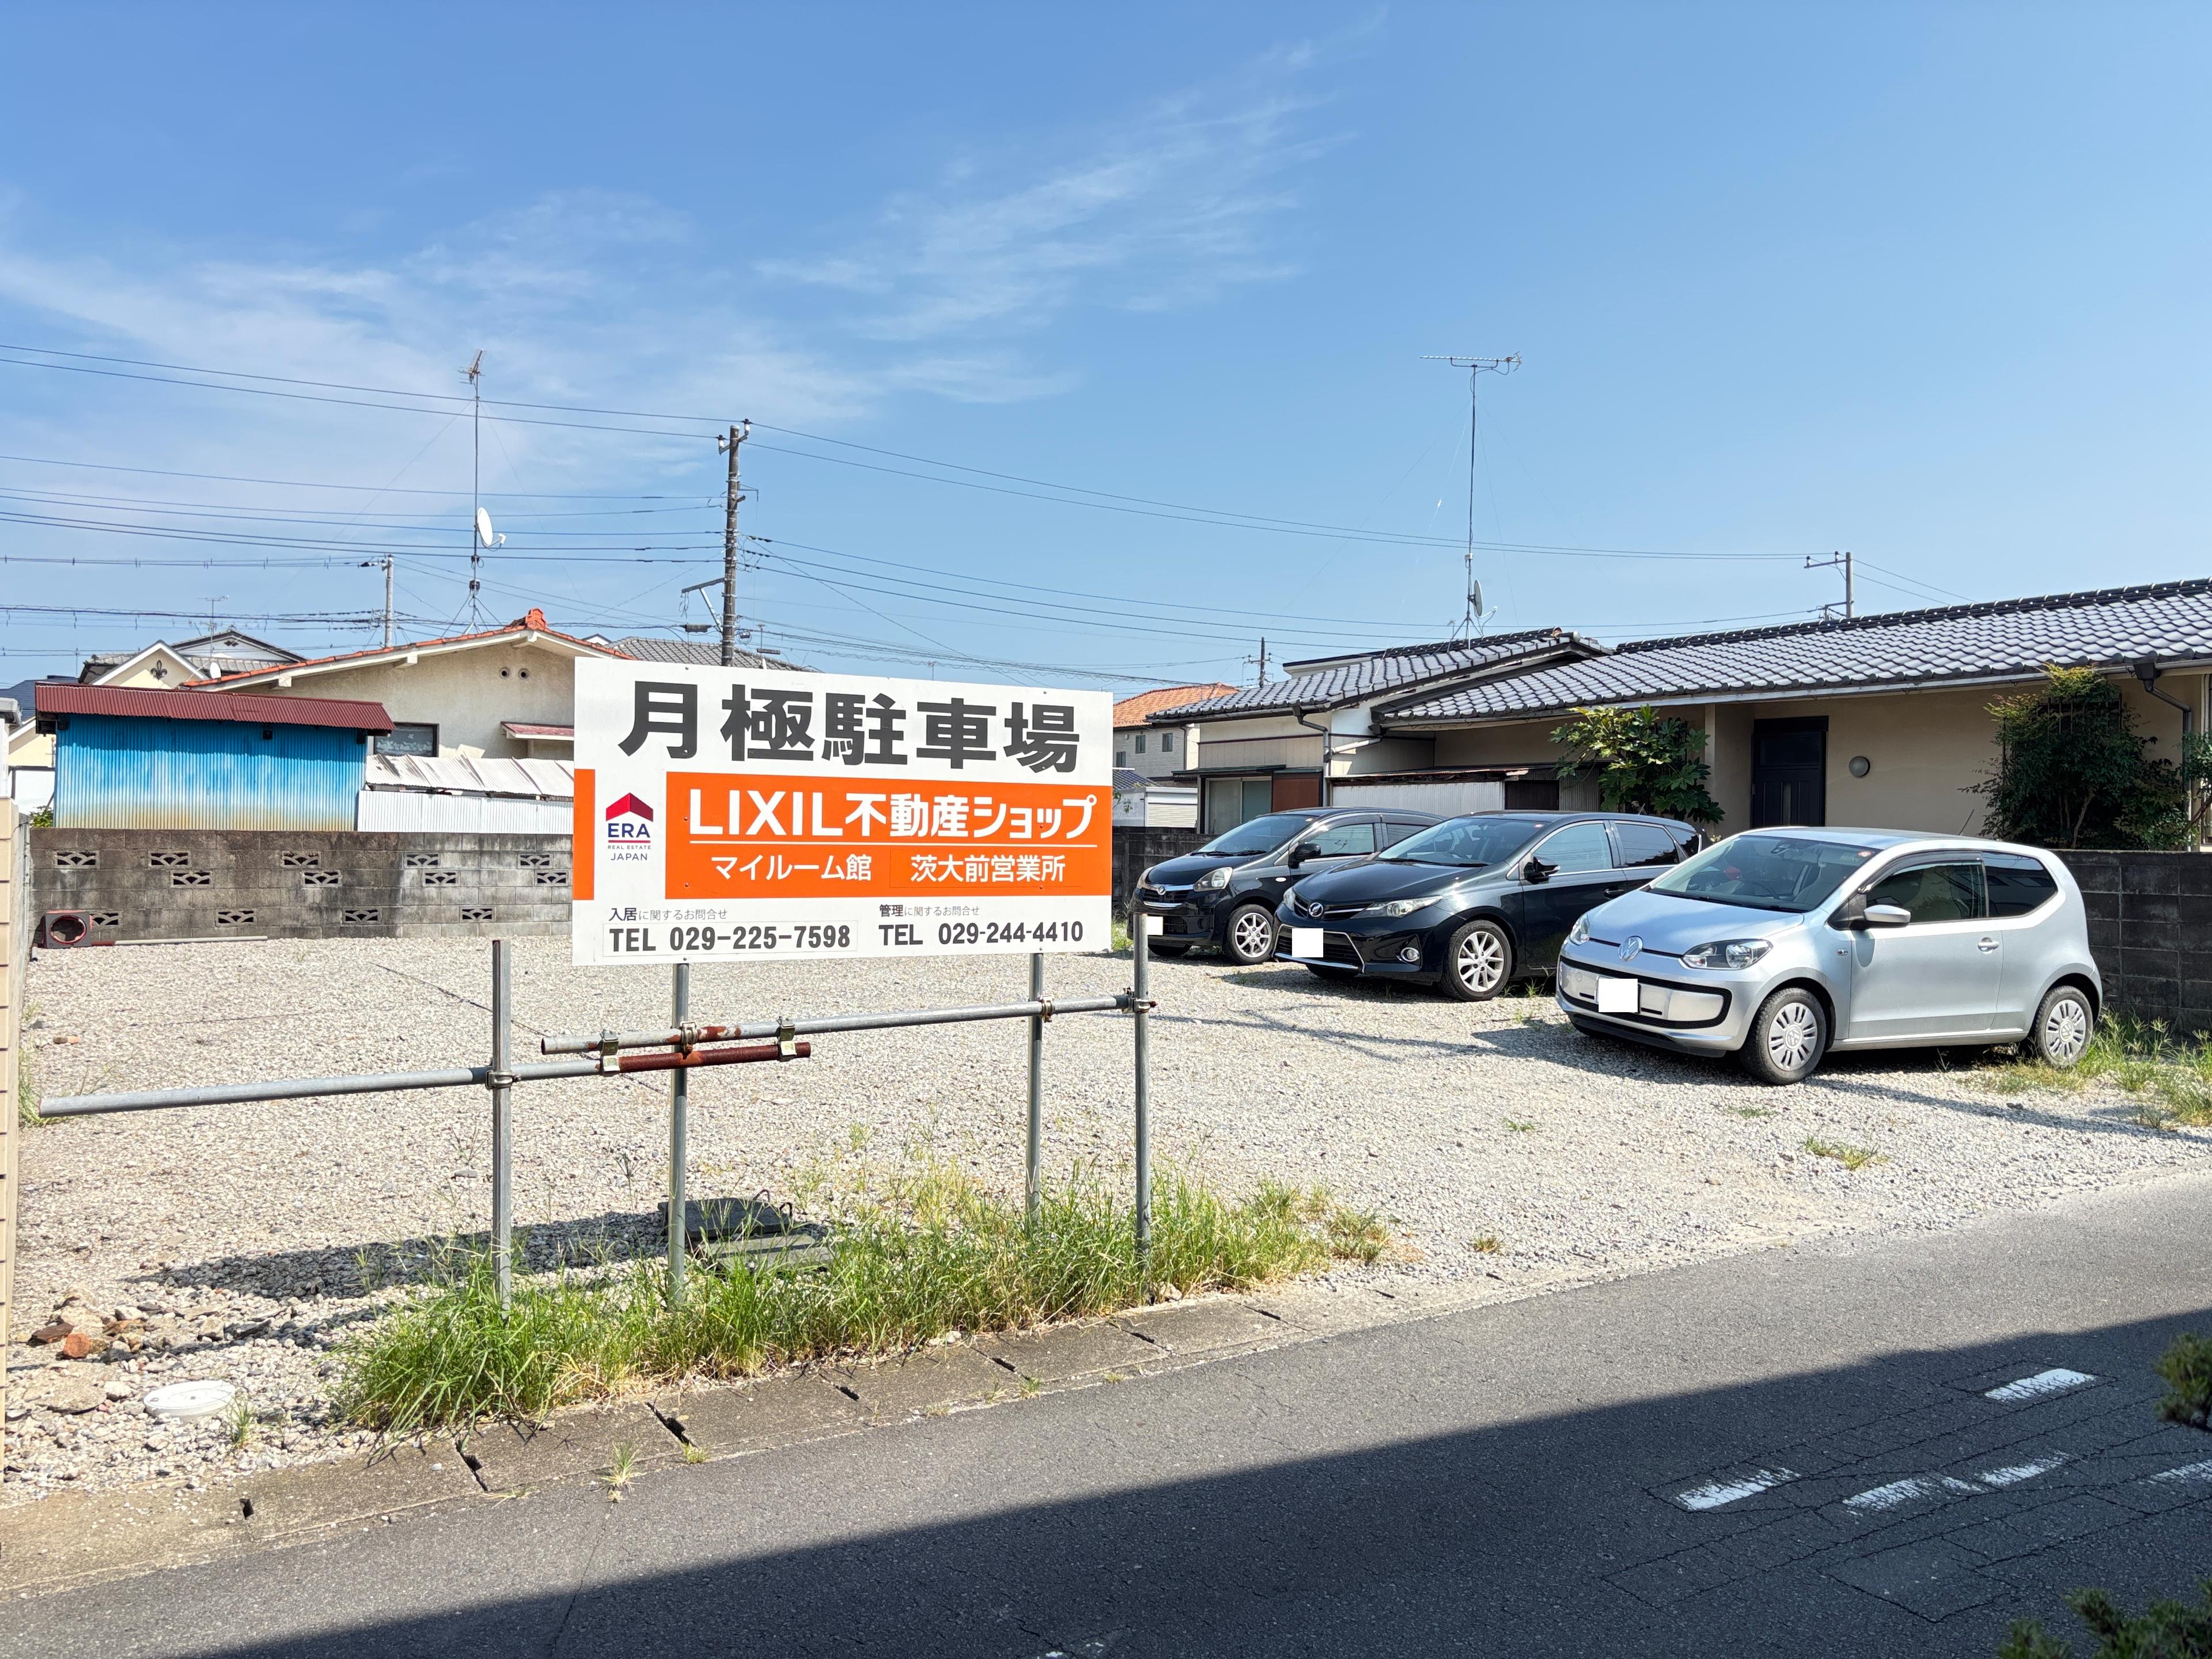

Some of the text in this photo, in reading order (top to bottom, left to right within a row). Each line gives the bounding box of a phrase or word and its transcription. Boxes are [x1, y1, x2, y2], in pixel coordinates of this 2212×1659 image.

[618, 681, 1080, 773] 月極駐車場
[690, 789, 1097, 839] LIXIL不動産ショップ
[608, 823, 651, 838] ERA
[611, 853, 647, 861] JAPAN
[711, 854, 1066, 882] マイルーム館 茨大前営業所
[608, 907, 728, 922] 入居に関するお問合せ
[879, 904, 980, 917] 管理に関するお問合せ
[609, 925, 851, 952] TEL 029-225-7598
[878, 921, 1084, 946] TEL 029-244-4410
